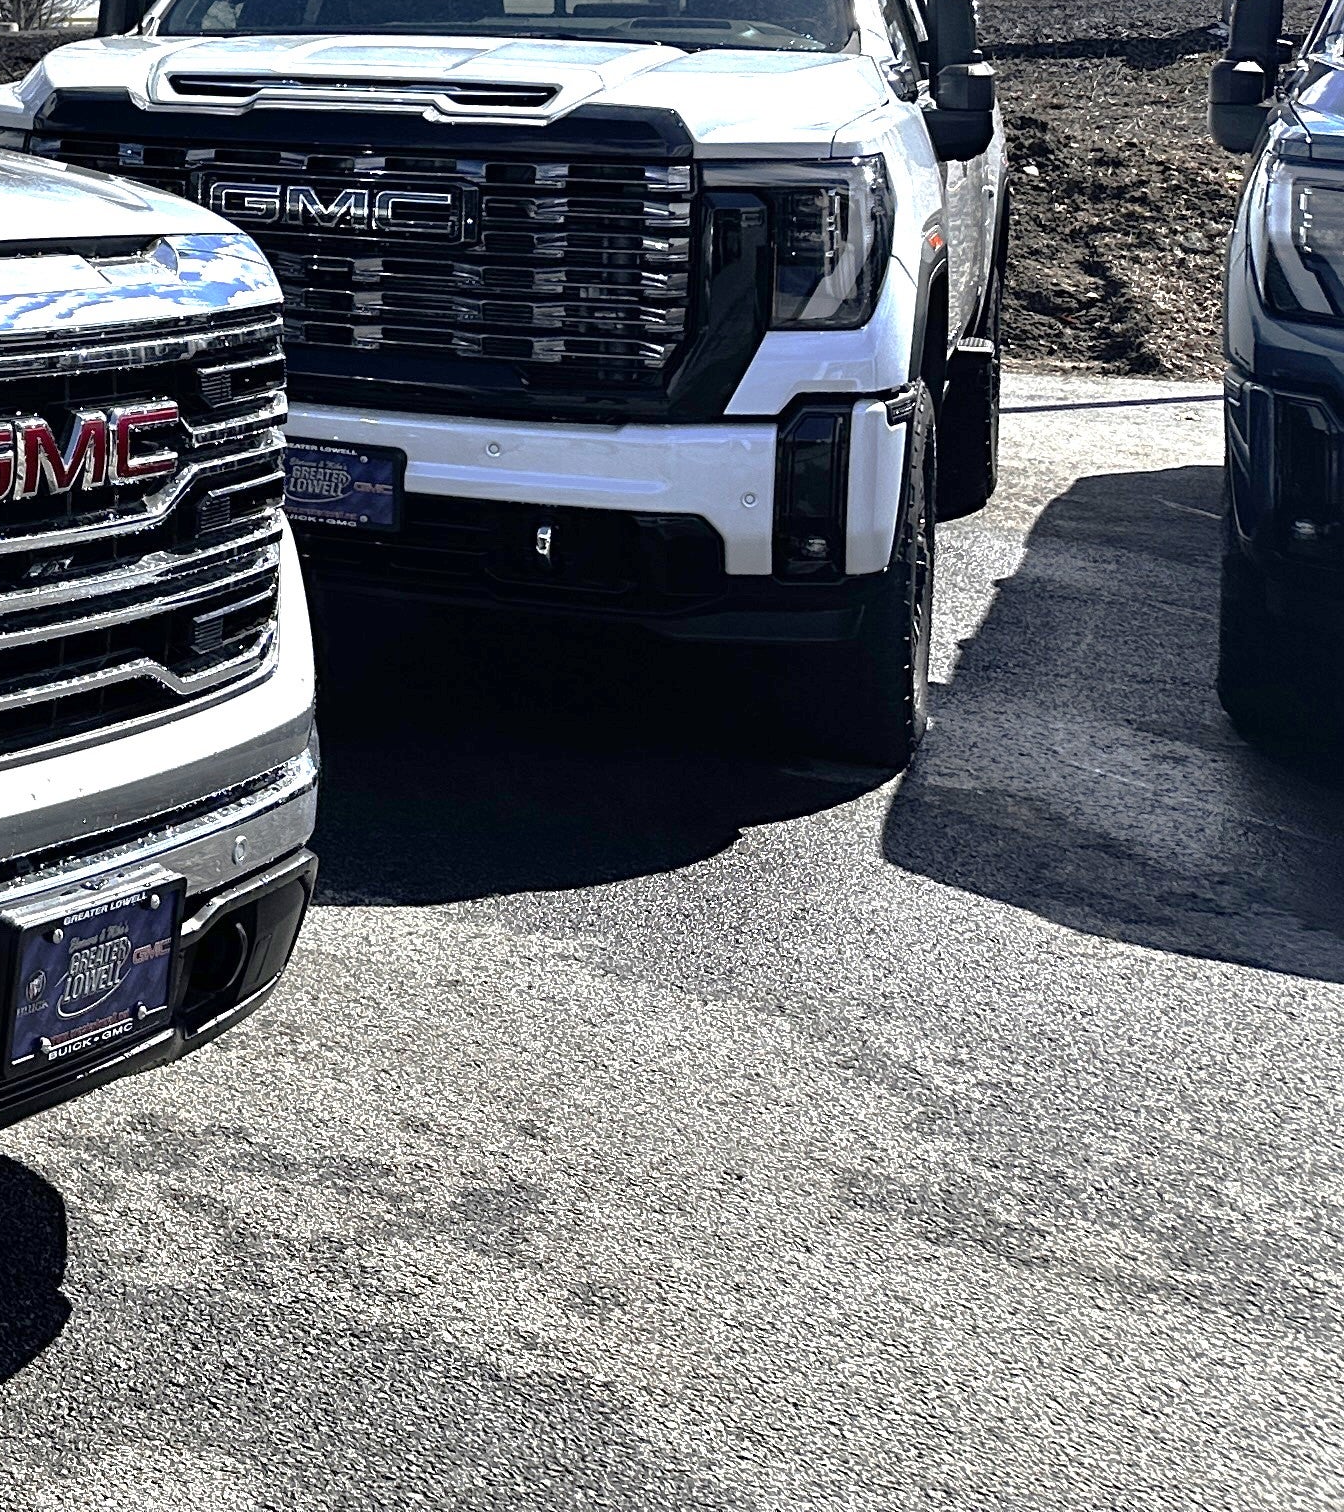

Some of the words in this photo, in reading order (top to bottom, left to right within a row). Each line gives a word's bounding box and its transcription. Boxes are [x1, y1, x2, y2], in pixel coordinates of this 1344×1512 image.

[210, 181, 452, 234] GMC
[320, 446, 358, 456] LOWELL
[289, 477, 343, 496] LOWELL
[292, 466, 348, 485] GREATER
[63, 904, 108, 926] GREATER
[110, 891, 148, 911] LOWELL
[70, 937, 129, 975] GREATER
[132, 937, 172, 965] GMC
[62, 961, 123, 1004] LOWELL
[48, 1040, 92, 1061] BUICK
[101, 1022, 134, 1042] GMC
